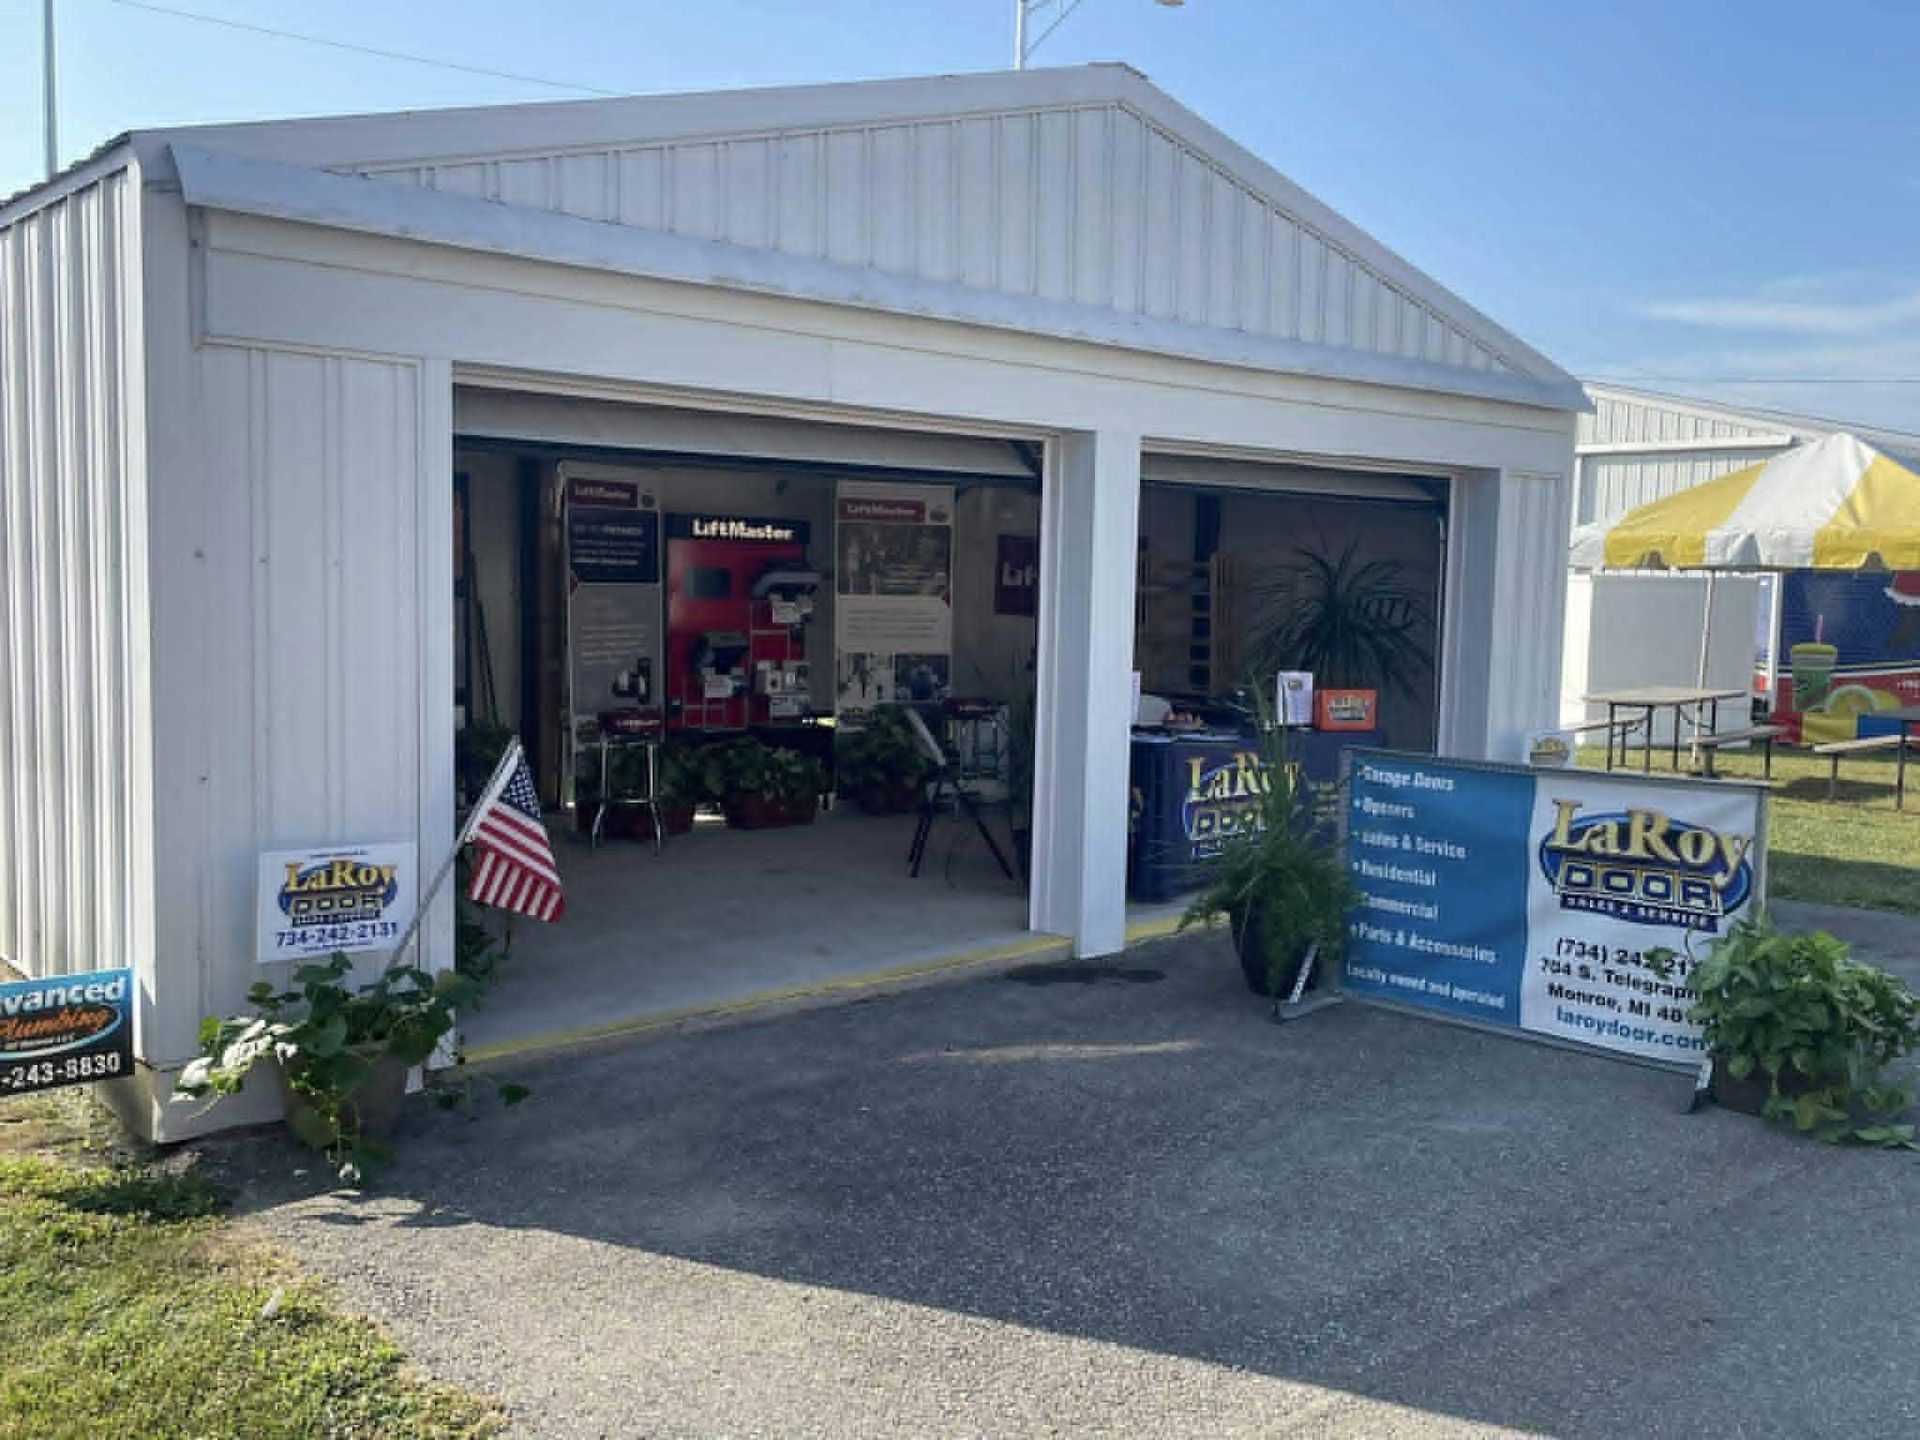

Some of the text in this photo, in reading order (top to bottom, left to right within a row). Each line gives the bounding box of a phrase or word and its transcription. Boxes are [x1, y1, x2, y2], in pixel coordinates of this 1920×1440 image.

[691, 519, 795, 540] LiftMaster
[1545, 798, 1752, 894] LaRoy
[284, 859, 398, 894] LaRoy
[1560, 861, 1718, 914] DOOR
[1361, 892, 1439, 922] ommercial
[1556, 936, 1607, 964] (734)
[0, 976, 126, 1017] vanced
[1548, 981, 1623, 1014] Monroe,
[1628, 999, 1651, 1019] MI
